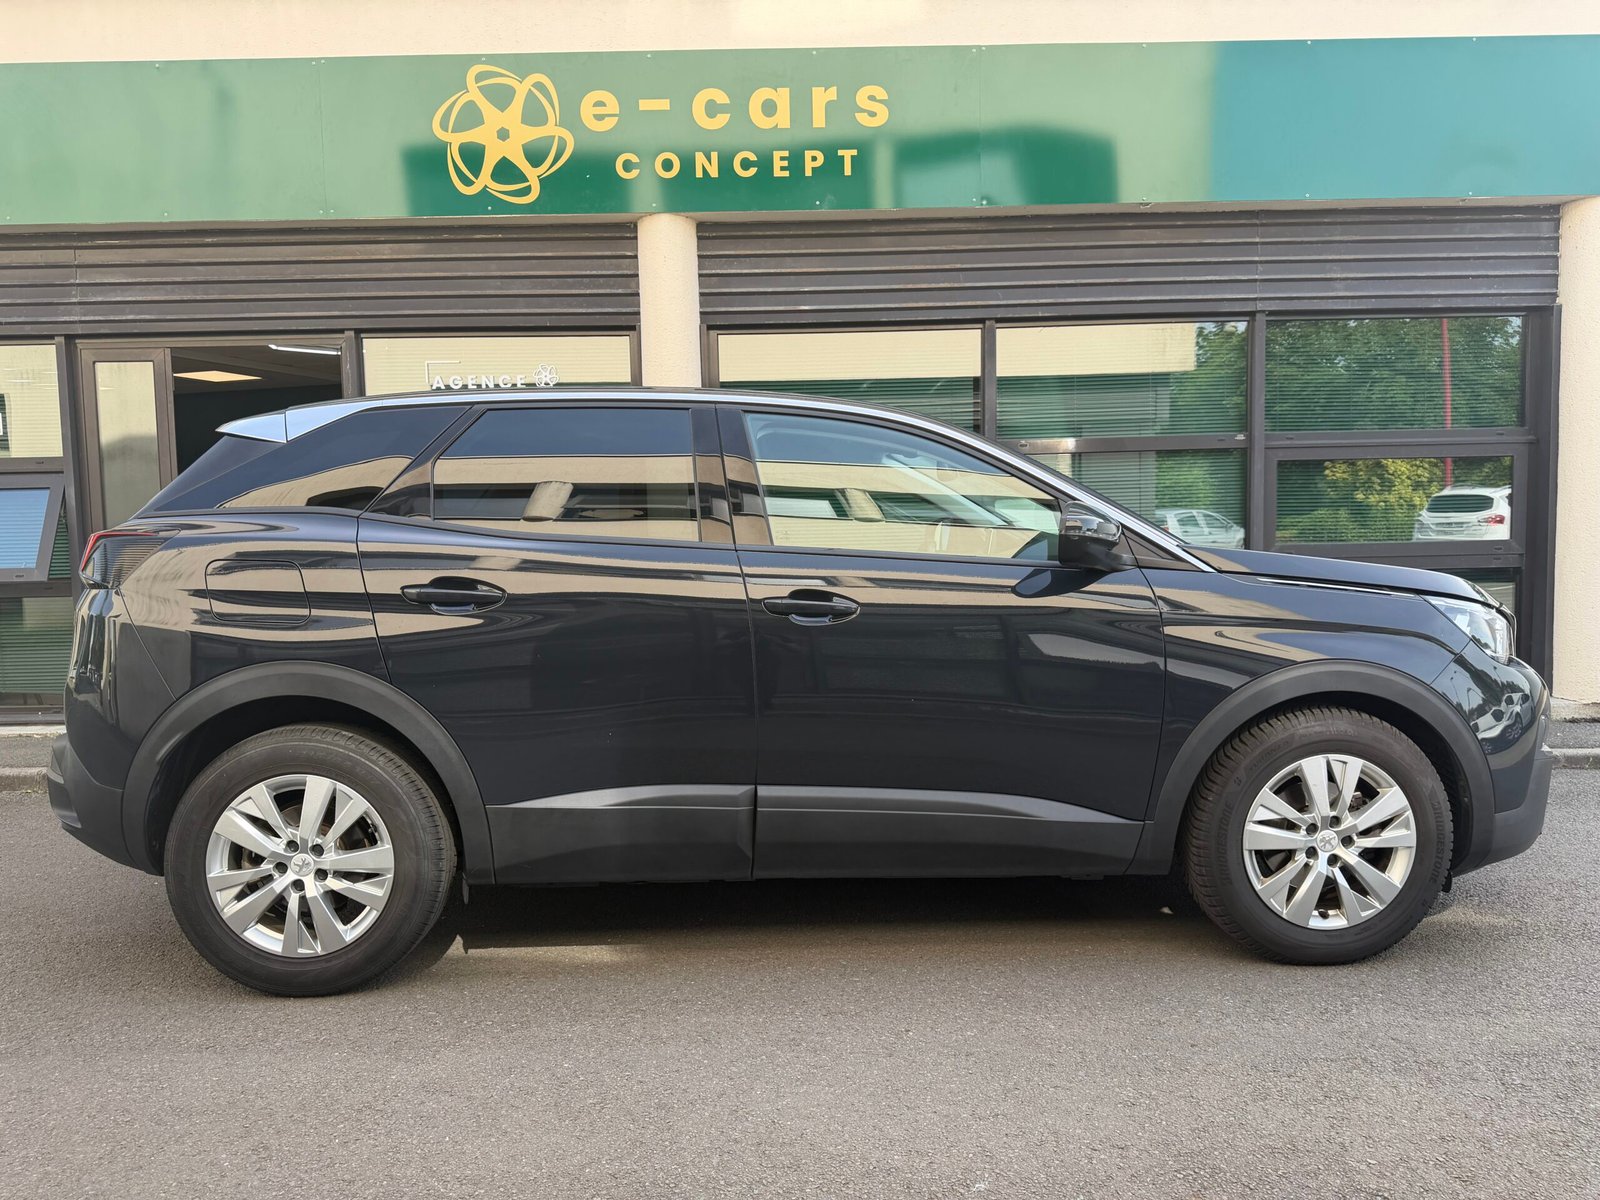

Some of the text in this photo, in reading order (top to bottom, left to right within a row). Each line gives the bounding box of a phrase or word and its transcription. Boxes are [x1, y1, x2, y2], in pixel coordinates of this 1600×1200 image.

[580, 84, 889, 132] e-cars
[615, 149, 858, 179] CONCEPT
[432, 374, 527, 390] AGENCE
